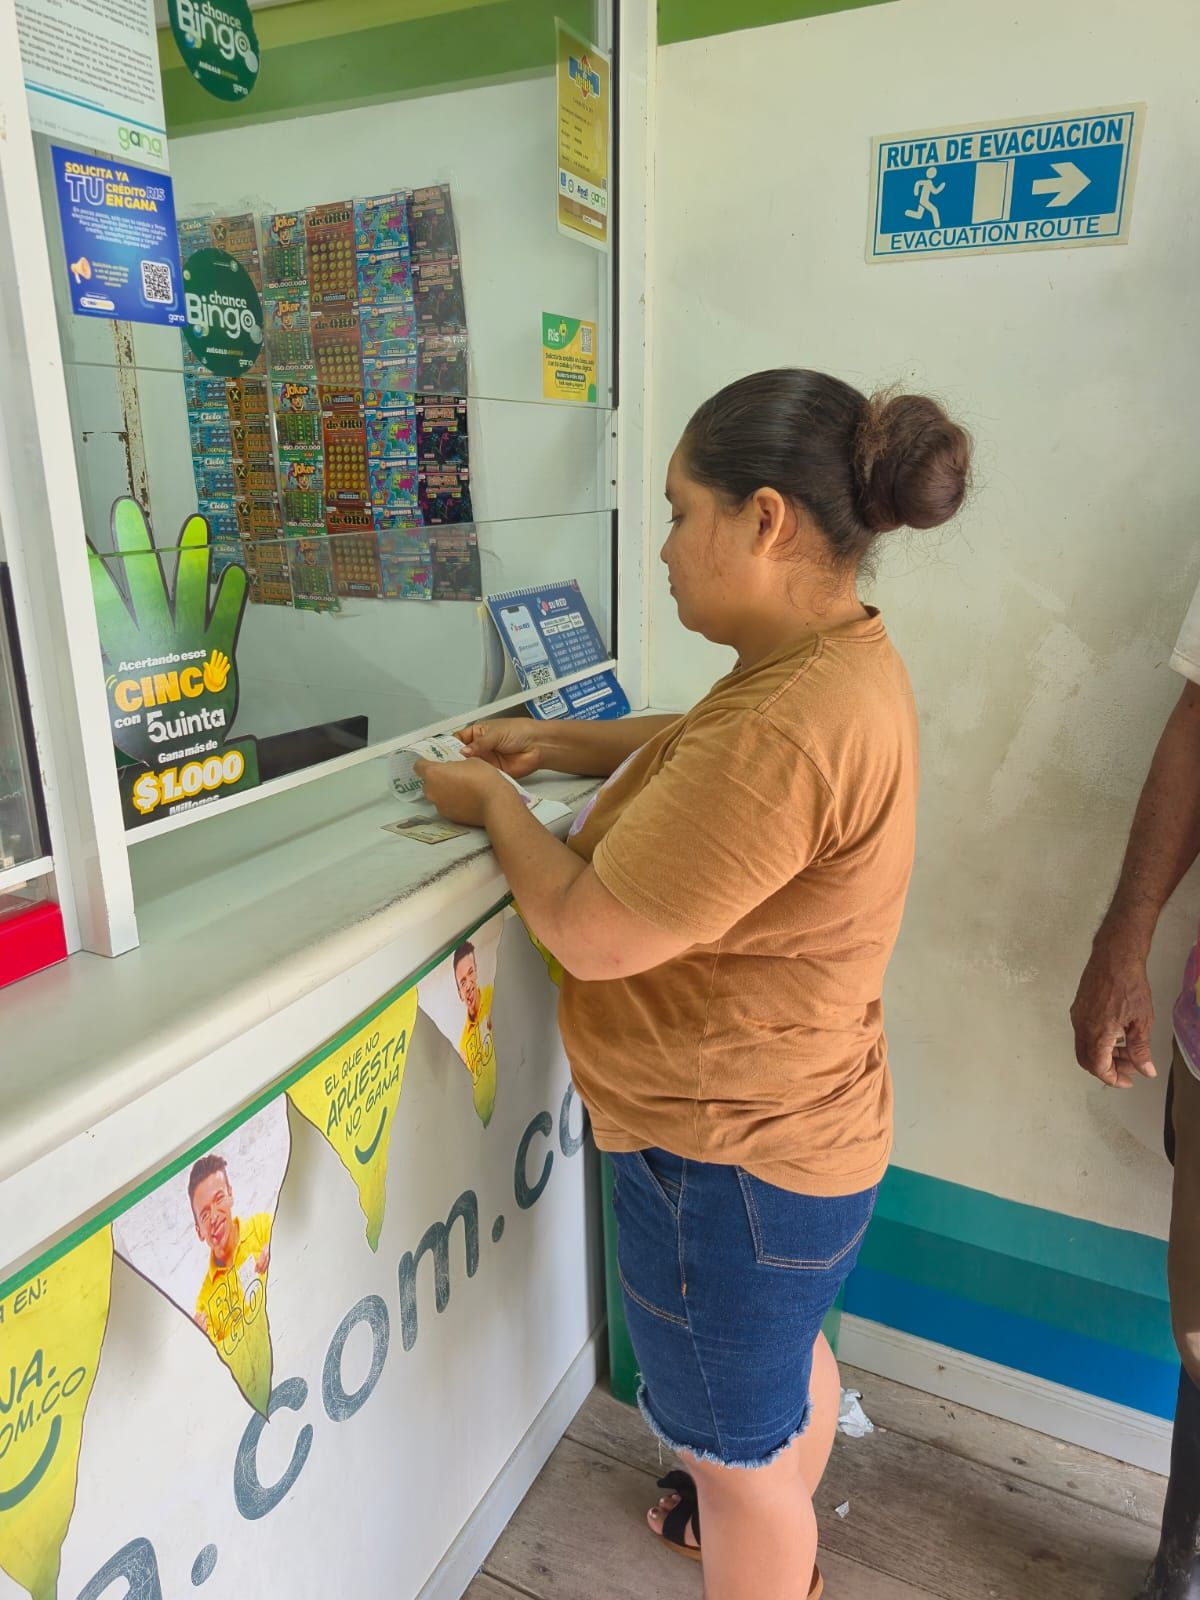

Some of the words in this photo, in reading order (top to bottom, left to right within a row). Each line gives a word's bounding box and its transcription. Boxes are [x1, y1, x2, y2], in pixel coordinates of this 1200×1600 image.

[201, 1, 241, 30] chance
[118, 126, 162, 153] gana
[886, 142, 939, 169] RUTA
[946, 137, 973, 161] DE
[979, 118, 1124, 159] EVACUACION
[64, 162, 113, 180] SOLICITA
[116, 172, 129, 182] YA
[65, 173, 104, 206] TU
[106, 182, 146, 198] CRÉDITO
[106, 194, 123, 208] EN
[125, 196, 158, 213] GANA
[890, 223, 1018, 250] EVACUATION
[1025, 216, 1100, 240] ROUTE
[209, 290, 247, 308] chance
[185, 293, 256, 339] Bingo
[285, 384, 308, 398] Joker
[293, 463, 316, 477] Joker
[118, 653, 180, 672] Acertando
[181, 649, 207, 661] esos
[114, 714, 141, 729] con
[158, 750, 185, 764] Gana
[184, 744, 205, 757] más
[206, 739, 218, 750] de
[133, 750, 245, 815] $1.000
[324, 1074, 339, 1096] EL
[342, 1046, 362, 1079] QUE
[365, 1031, 380, 1056] NO
[326, 1029, 406, 1136] APUESTA
[346, 1106, 362, 1141] NO
[365, 1063, 400, 1113] GANA
[13, 1278, 48, 1314] EN:
